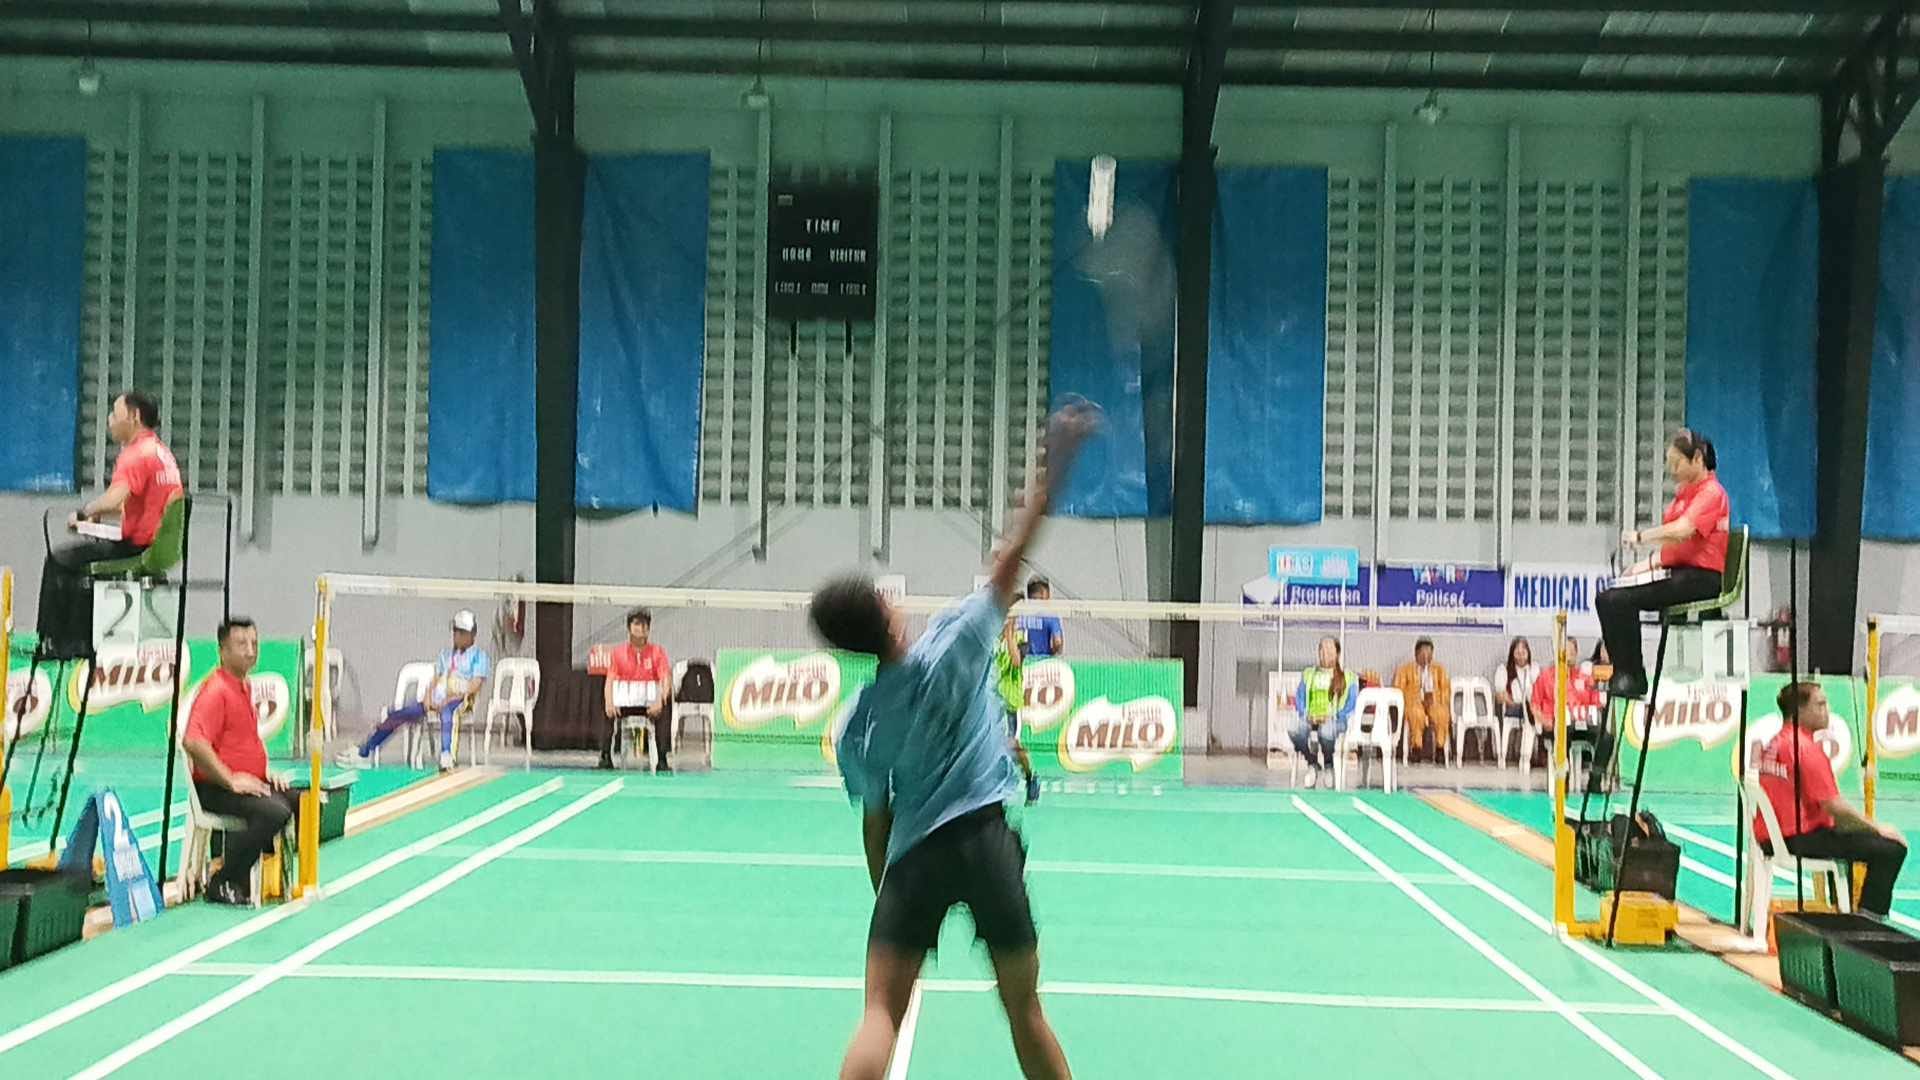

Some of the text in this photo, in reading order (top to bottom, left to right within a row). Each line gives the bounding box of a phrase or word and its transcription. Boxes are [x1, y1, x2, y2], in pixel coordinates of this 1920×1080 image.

[1514, 573, 1590, 611] MEDICAL
[740, 678, 829, 708] MILO
[1643, 700, 1732, 727] MILO
[1076, 717, 1165, 748] MILO
